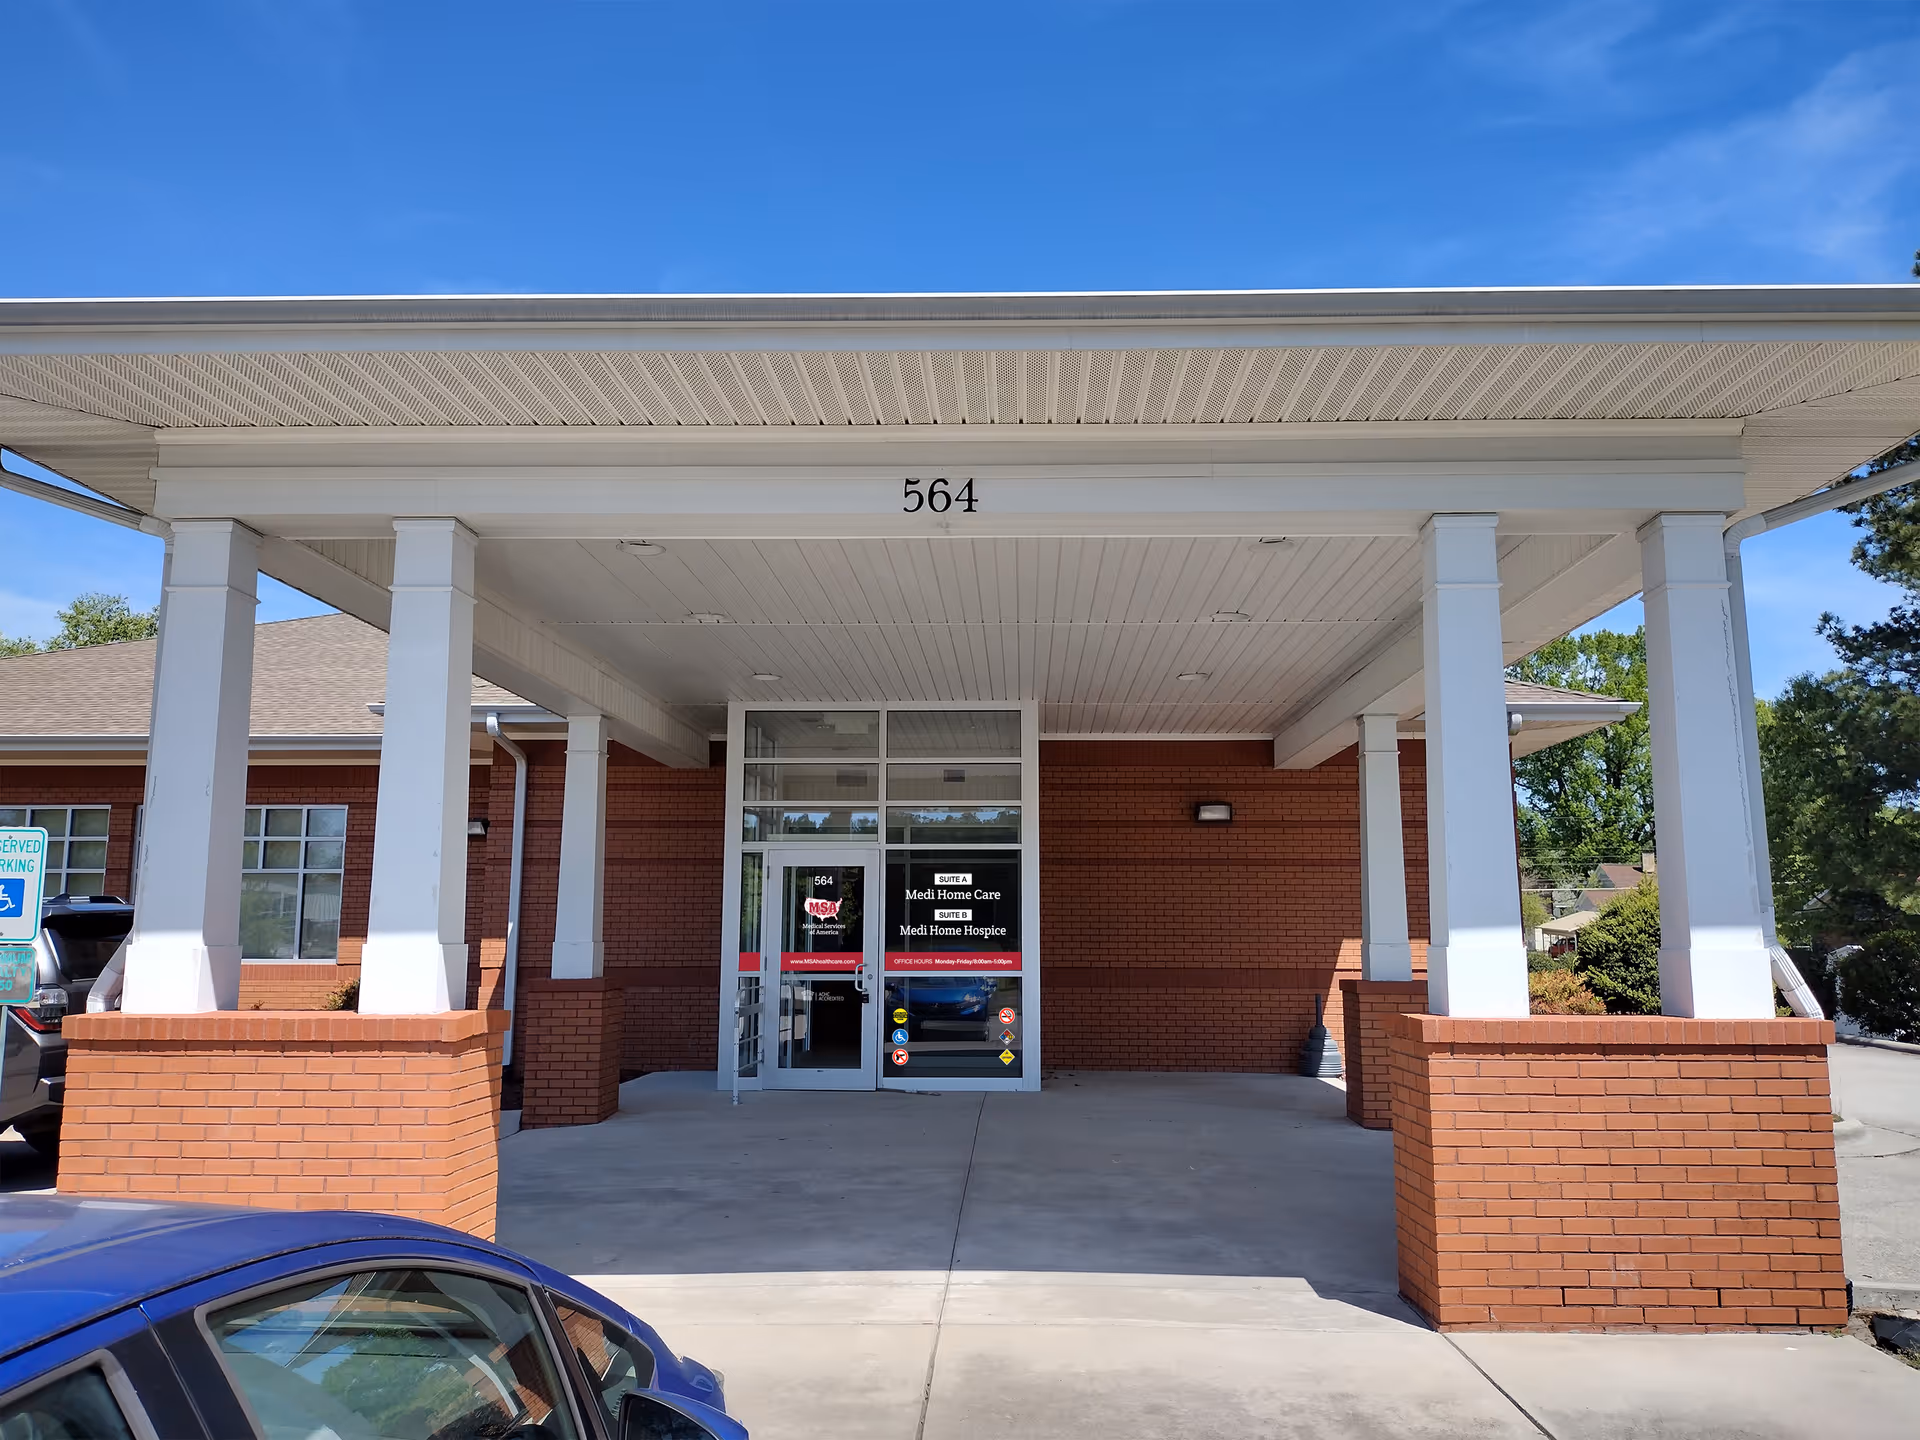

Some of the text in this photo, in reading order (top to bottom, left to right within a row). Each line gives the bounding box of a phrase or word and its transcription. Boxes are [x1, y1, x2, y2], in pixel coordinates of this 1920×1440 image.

[903, 477, 979, 513] 564
[0, 839, 41, 853] ERVED
[814, 876, 833, 885] 564
[905, 889, 1001, 900] Medi Home Care
[808, 902, 838, 914] MSA
[899, 925, 1007, 939] Medi Home Hospice
